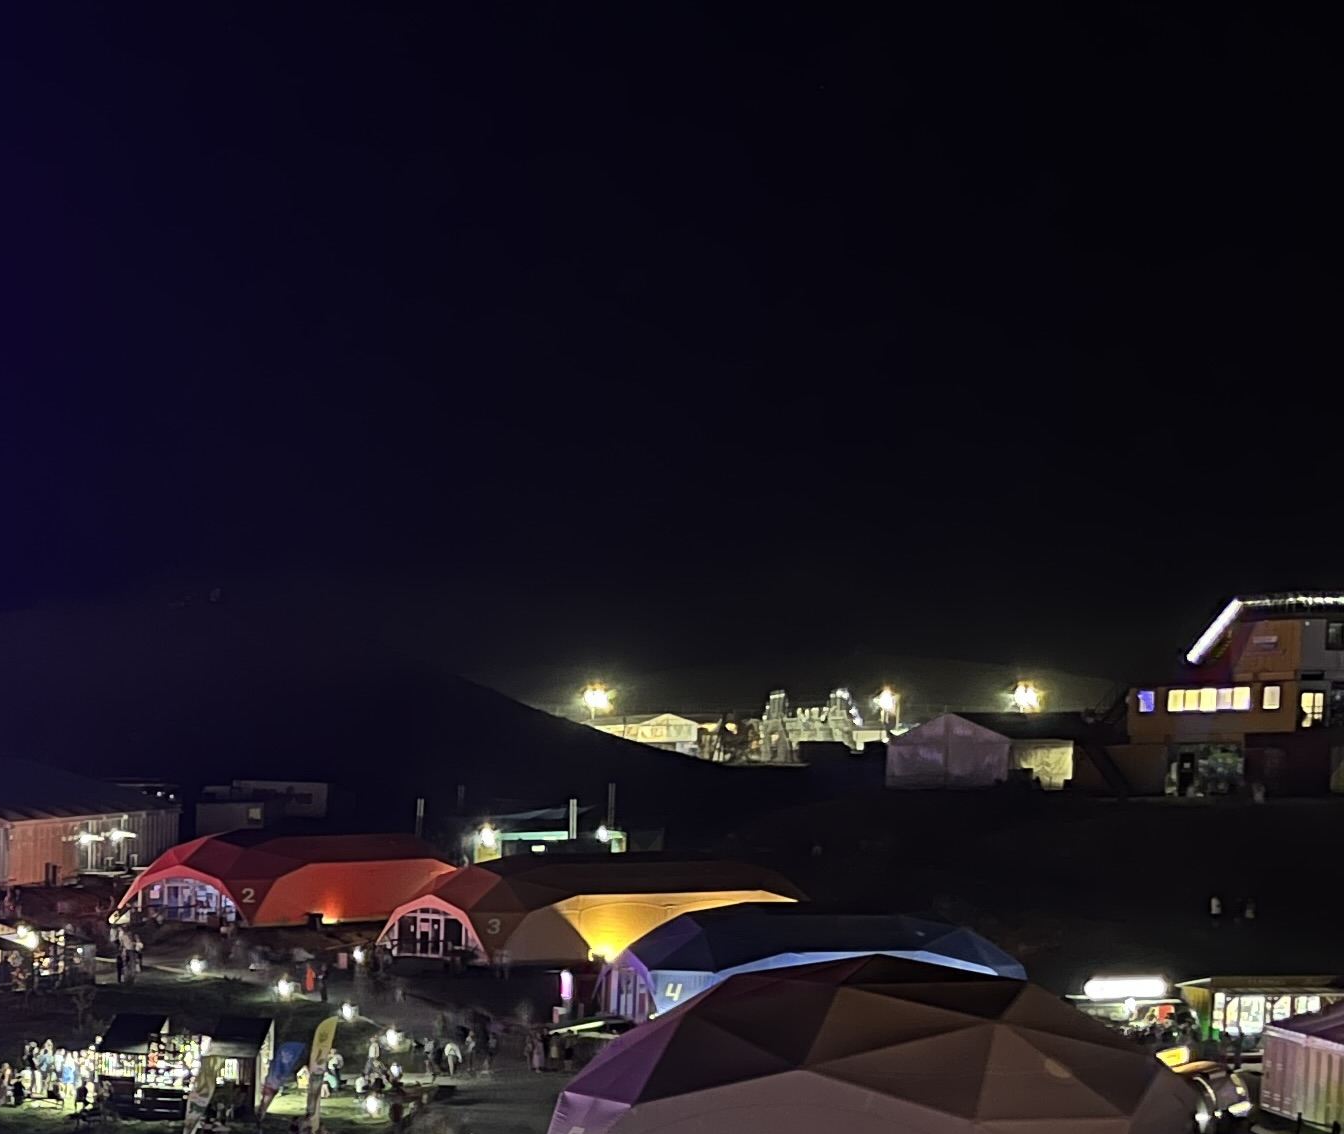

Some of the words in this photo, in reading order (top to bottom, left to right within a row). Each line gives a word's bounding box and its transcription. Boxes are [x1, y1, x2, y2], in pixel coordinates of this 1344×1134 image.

[240, 887, 257, 904] 2
[486, 918, 502, 935] 3
[665, 983, 683, 1001] 4
